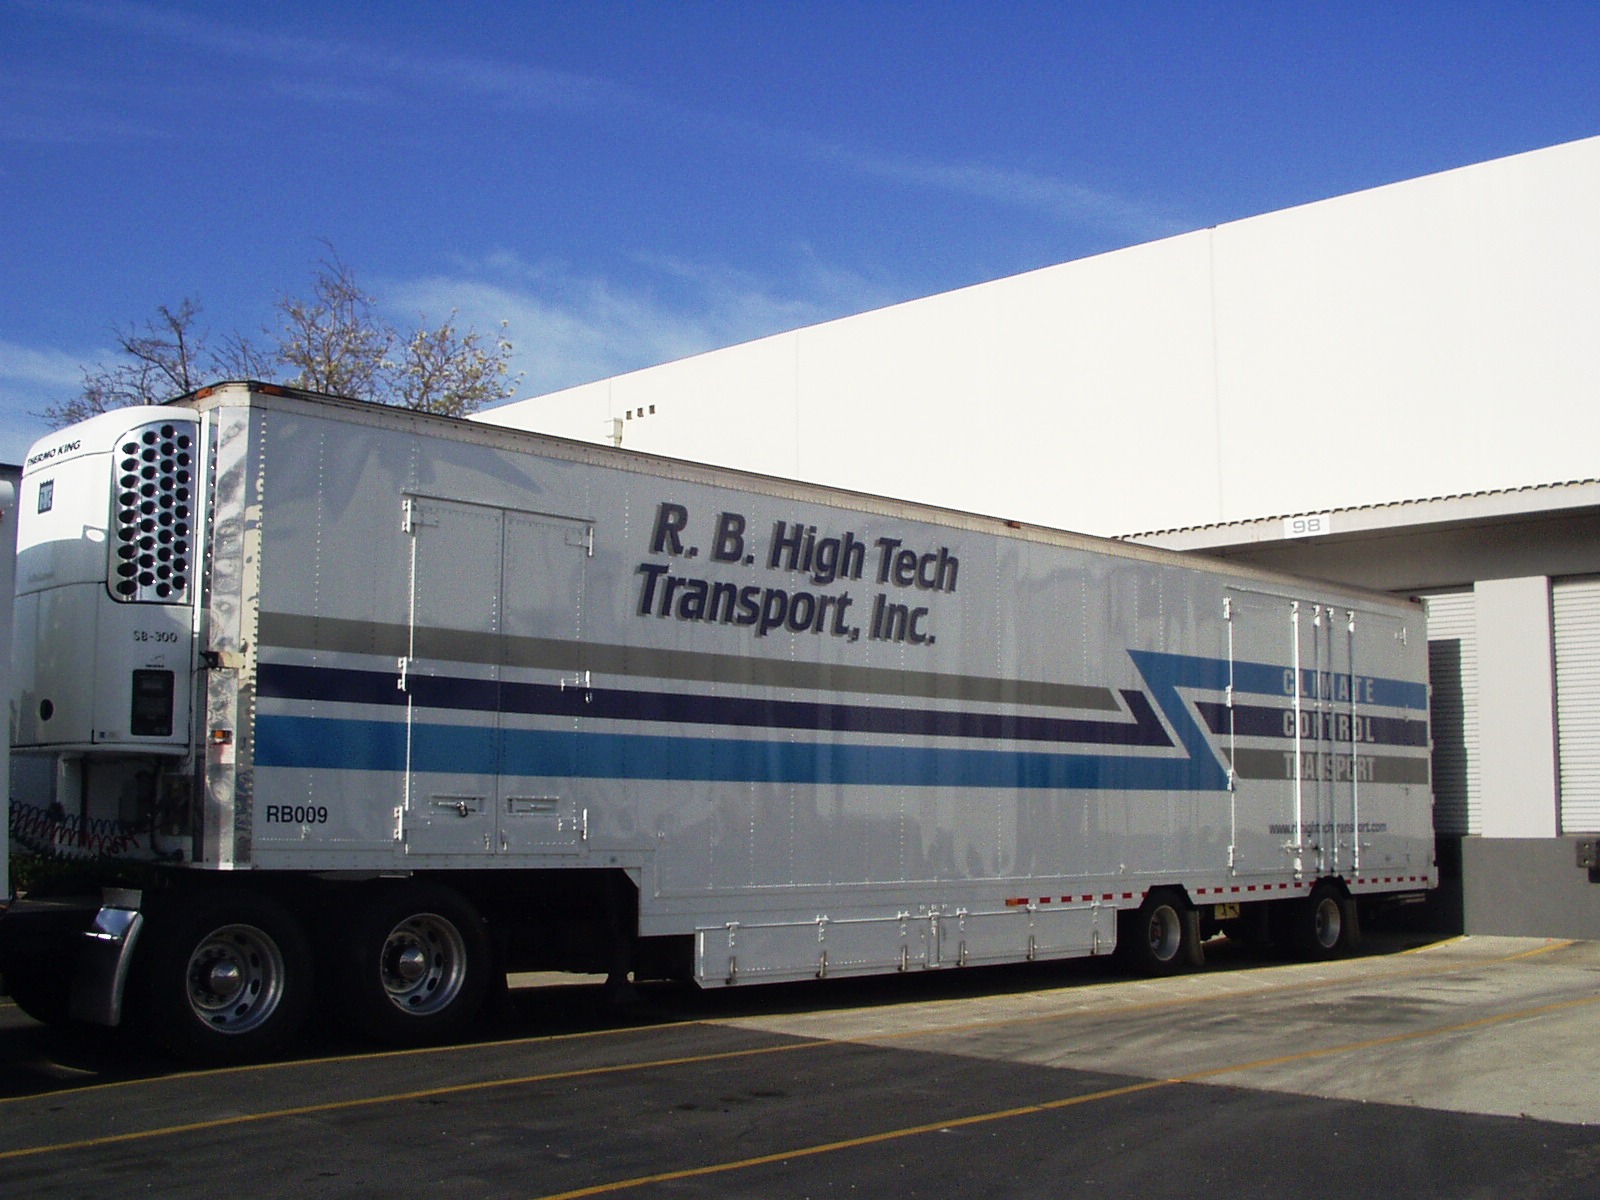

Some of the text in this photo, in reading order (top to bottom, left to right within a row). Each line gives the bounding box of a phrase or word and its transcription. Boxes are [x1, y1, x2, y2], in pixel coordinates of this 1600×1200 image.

[58, 440, 81, 455] KING
[1293, 518, 1321, 534] 98
[650, 502, 959, 593] R. B. High Tech
[635, 563, 936, 646] Transport, Inc.
[133, 630, 178, 643] SB-300
[1283, 752, 1376, 781] TASPORT
[266, 805, 328, 824] RB009
